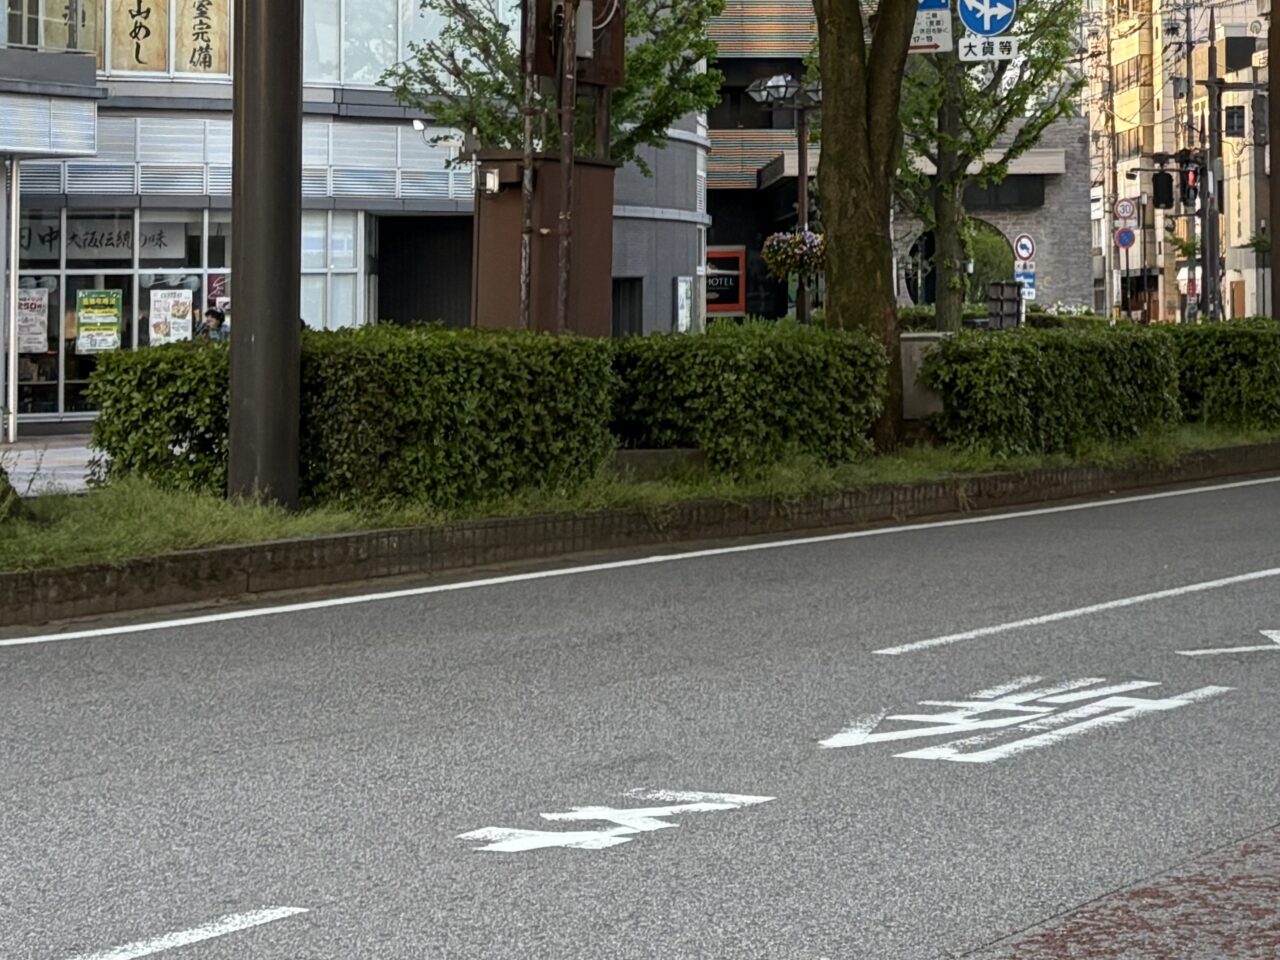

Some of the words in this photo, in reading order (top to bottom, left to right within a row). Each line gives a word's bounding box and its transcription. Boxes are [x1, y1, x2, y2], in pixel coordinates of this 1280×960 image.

[963, 41, 1013, 57] 大貨等
[1119, 204, 1132, 215] 30
